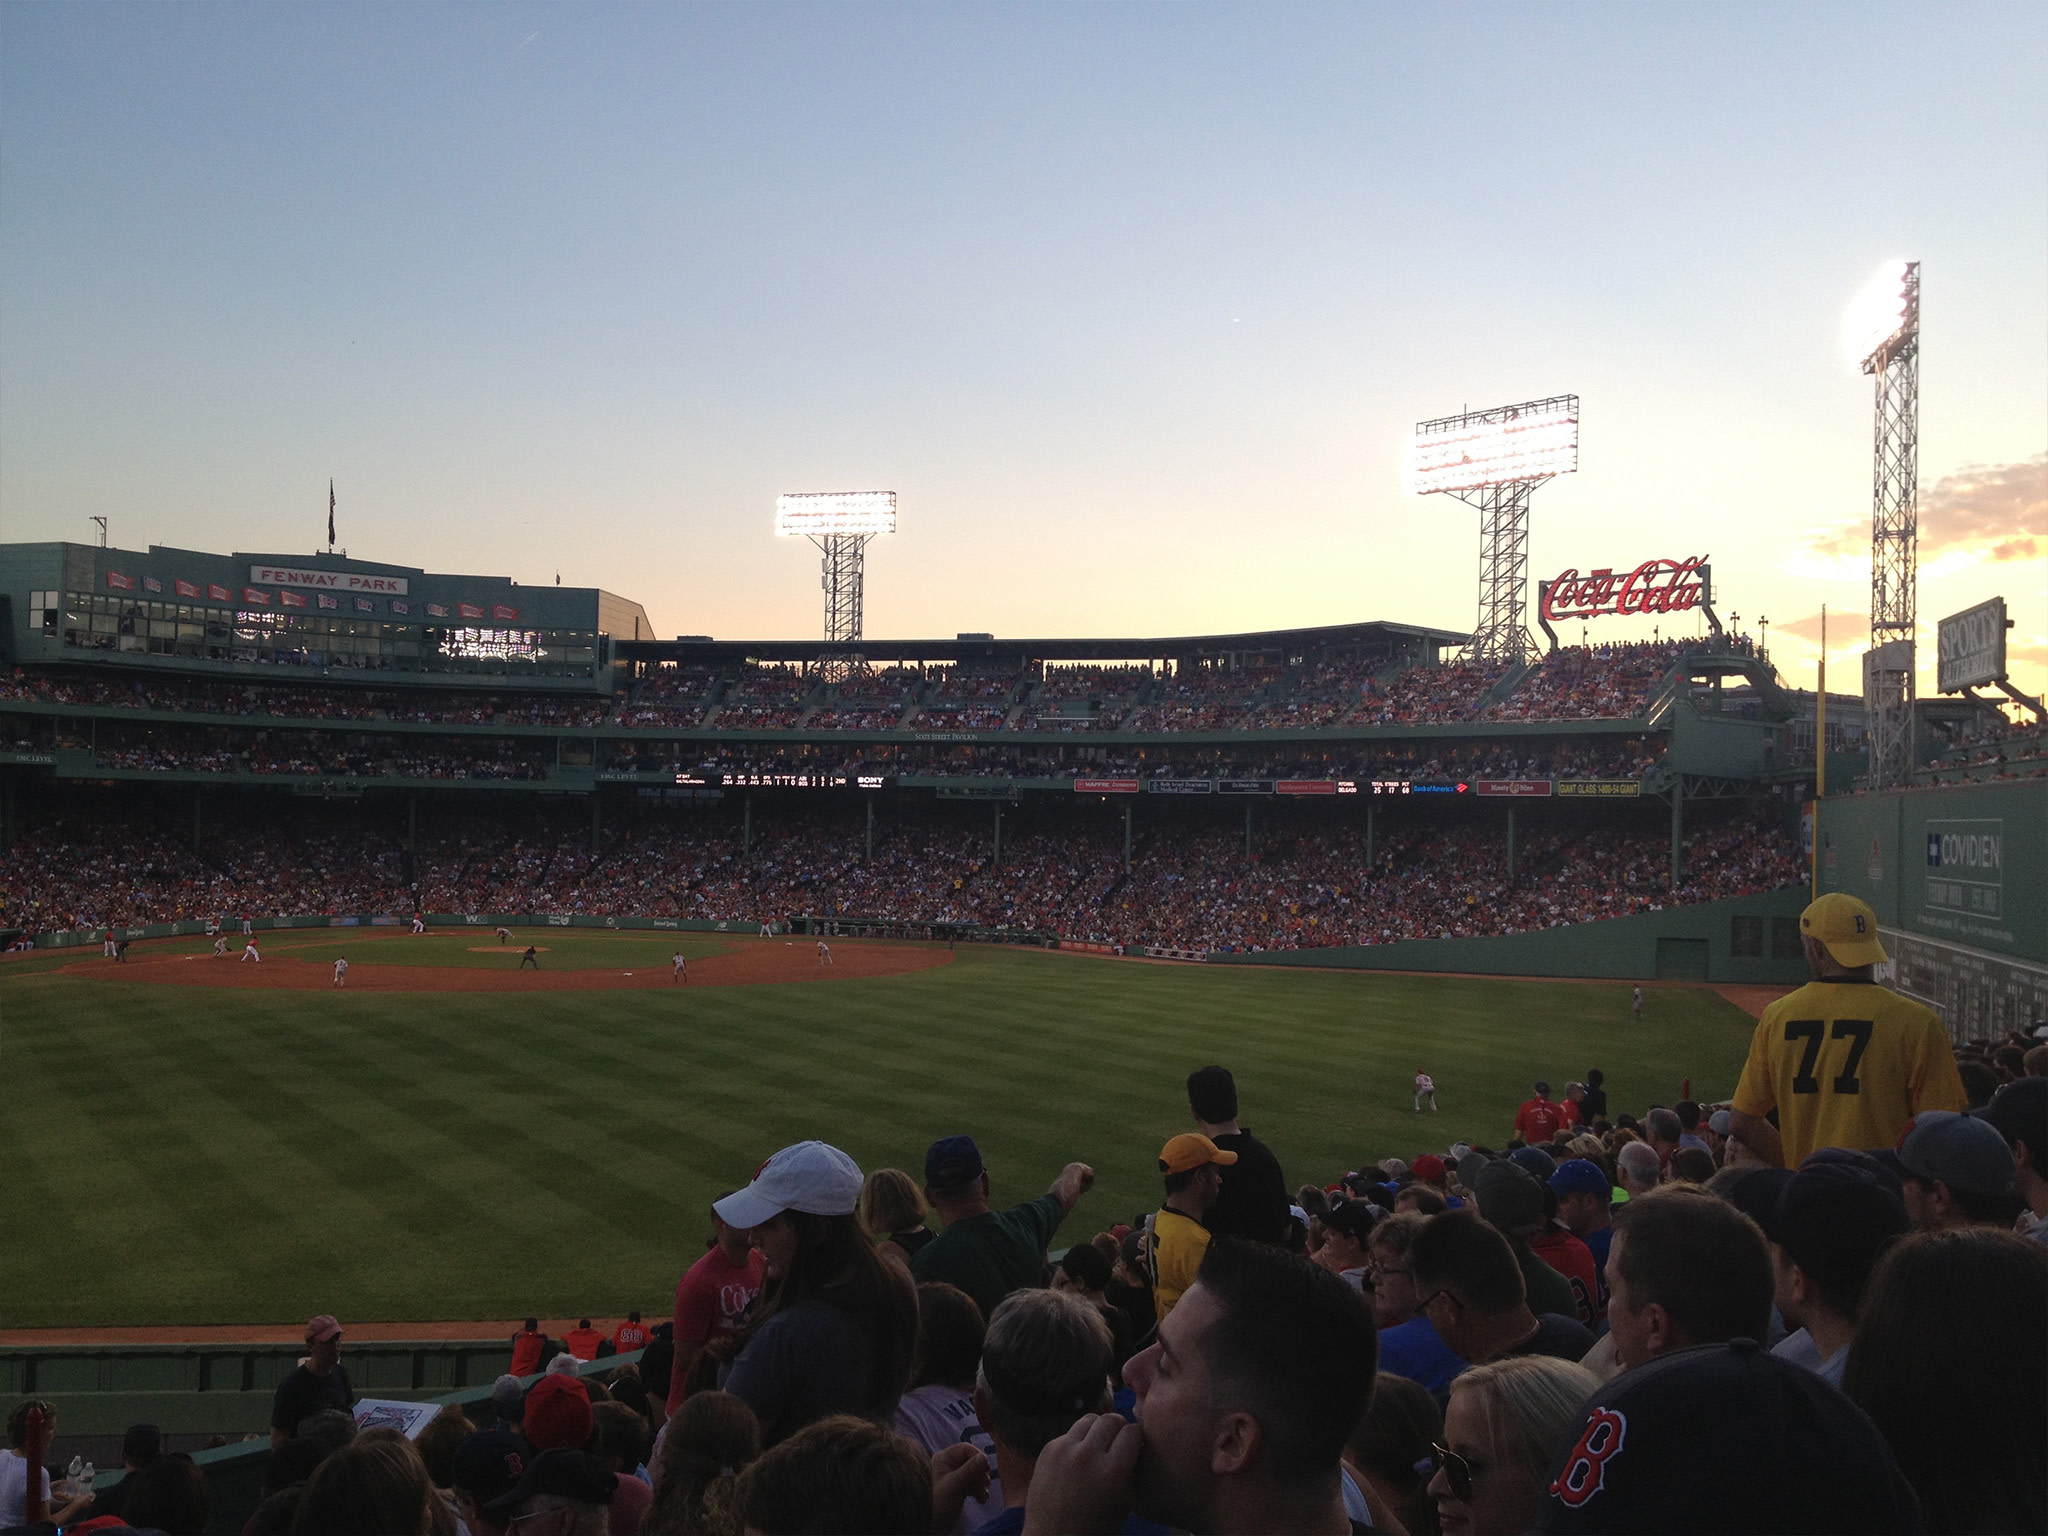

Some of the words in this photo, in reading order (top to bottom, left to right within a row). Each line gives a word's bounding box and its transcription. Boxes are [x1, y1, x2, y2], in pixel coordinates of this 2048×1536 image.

[261, 570, 337, 586] FENWAY
[349, 578, 398, 591] PARK
[1542, 554, 1710, 621] Coca-Cola
[1942, 606, 1999, 662] SPORTS
[1491, 784, 1509, 792] Ninety
[1560, 784, 1577, 794] GIANT
[1578, 784, 1596, 794] GLASS
[1620, 784, 1638, 794] GIANT
[1942, 834, 1999, 868] COVIDIEN
[1853, 915, 1867, 933] B
[1784, 1018, 1874, 1094] 77
[504, 1452, 523, 1477] B
[1549, 1406, 1626, 1508] B
